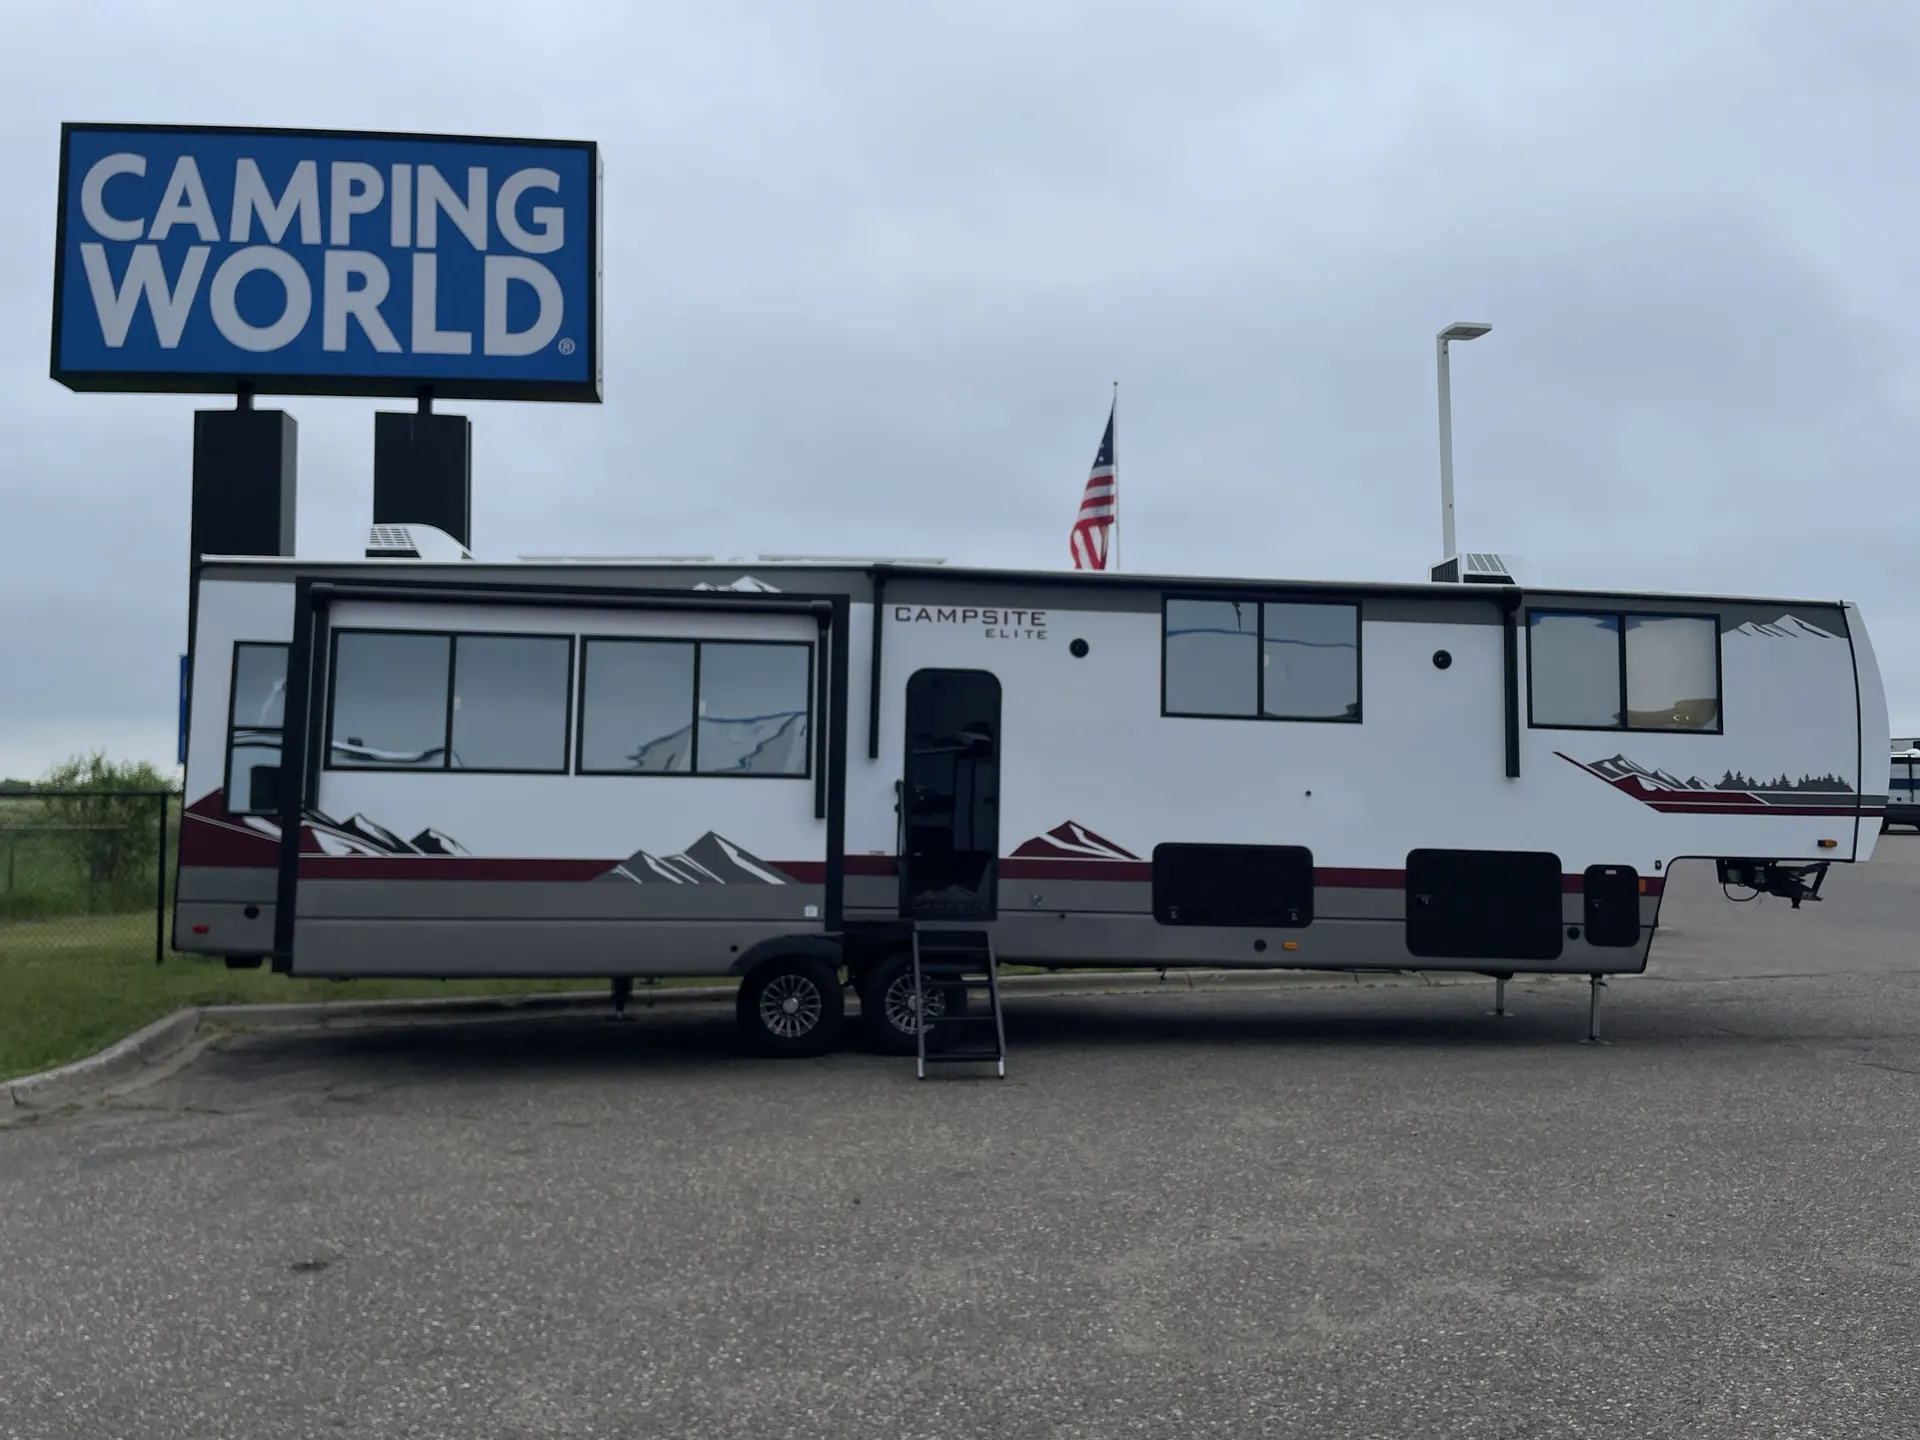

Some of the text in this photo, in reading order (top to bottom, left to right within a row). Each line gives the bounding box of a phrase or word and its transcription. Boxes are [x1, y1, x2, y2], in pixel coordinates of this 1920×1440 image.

[80, 153, 565, 254] CAMPING
[895, 606, 1046, 626] CAMPSITE
[985, 628, 1047, 640] ELITE
